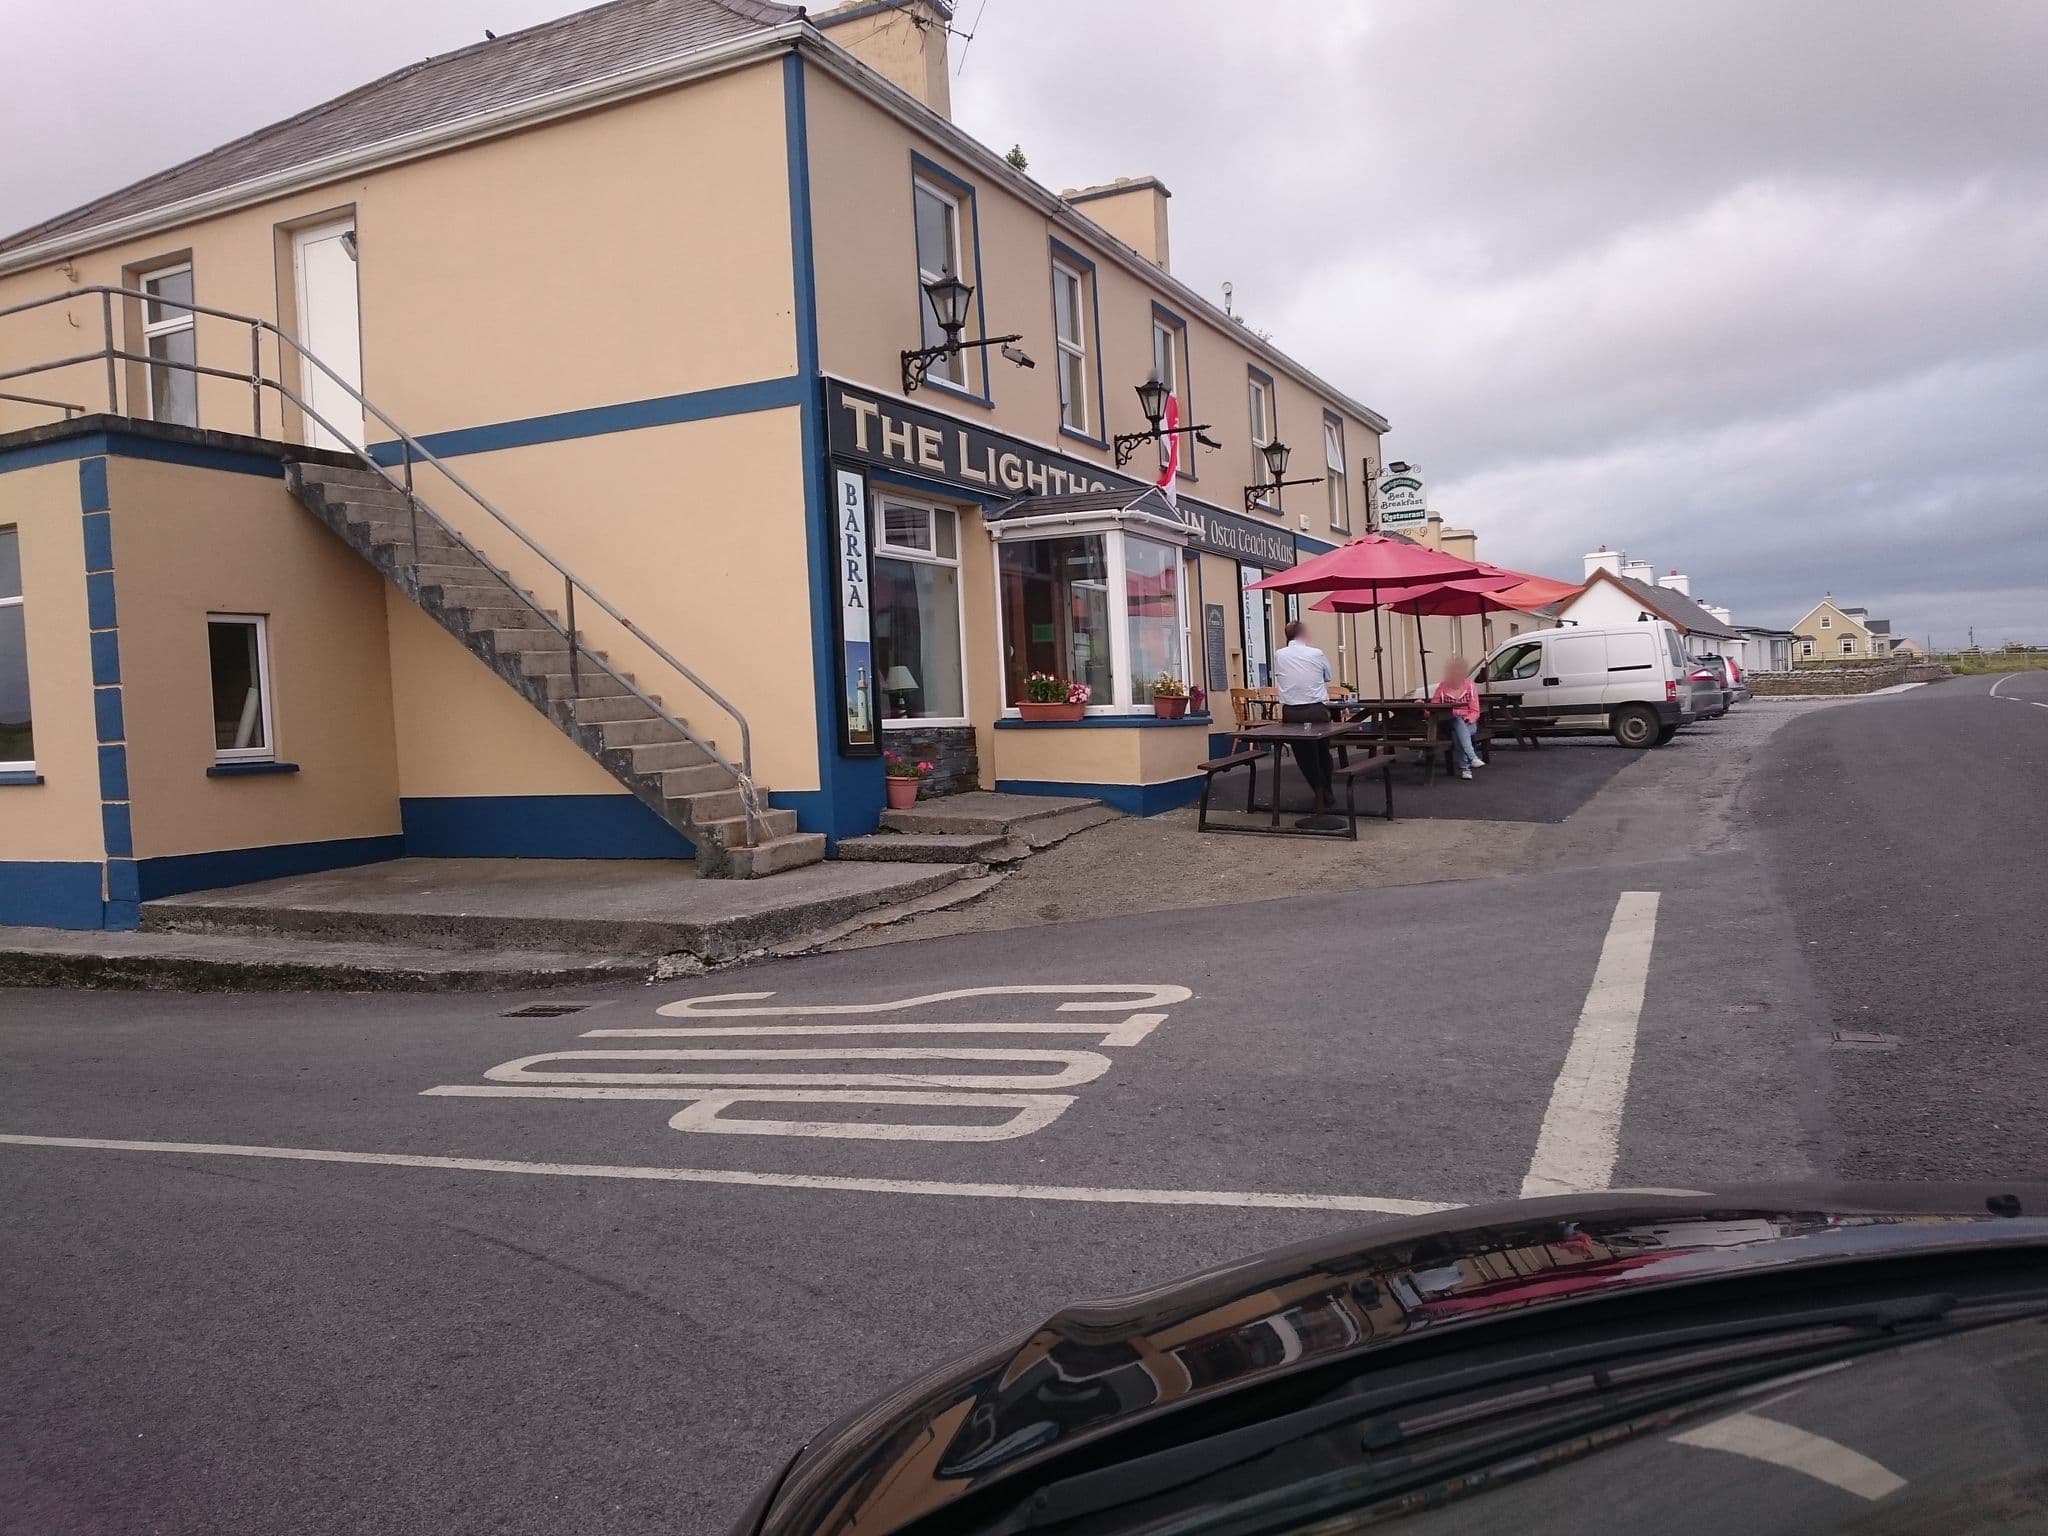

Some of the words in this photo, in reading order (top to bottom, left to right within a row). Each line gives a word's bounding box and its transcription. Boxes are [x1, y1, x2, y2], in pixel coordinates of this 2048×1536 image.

[842, 392, 945, 474] THE
[845, 482, 864, 609] BARRA
[1380, 498, 1424, 510] Breakfast
[1388, 491, 1405, 501] Bed
[1408, 491, 1415, 499] &
[1243, 571, 1256, 688] RESTAURA
[418, 984, 1193, 1142] STOP
